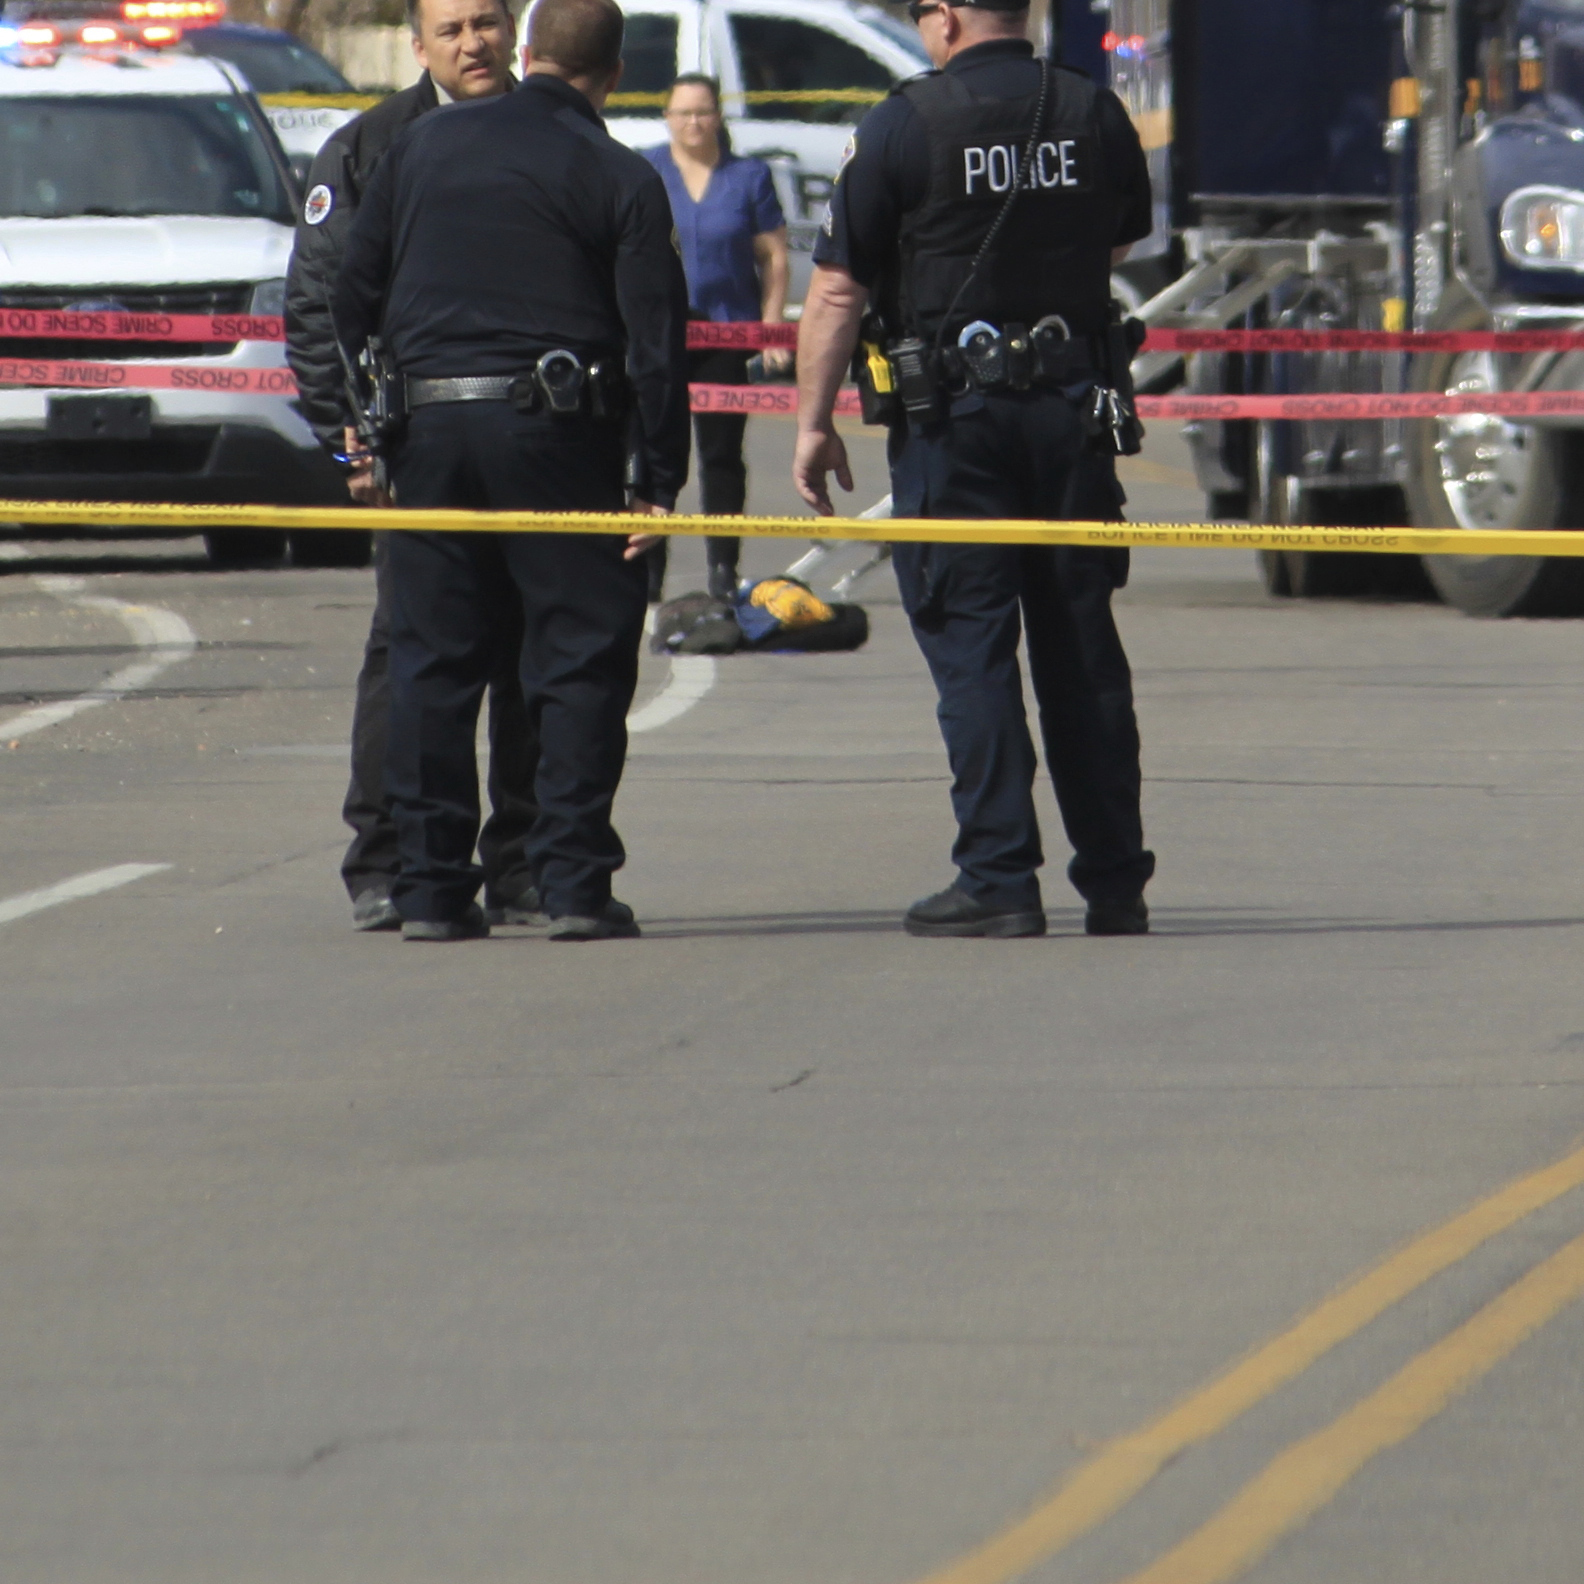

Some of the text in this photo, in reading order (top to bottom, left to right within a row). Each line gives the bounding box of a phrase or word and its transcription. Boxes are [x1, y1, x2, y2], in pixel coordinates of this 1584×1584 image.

[964, 140, 1079, 195] POLICE
[8, 311, 37, 332] DO
[43, 314, 106, 335] SCENE
[113, 316, 173, 337] CRIME
[211, 318, 280, 340] CROSS
[56, 363, 125, 385] CRIME
[171, 367, 248, 389] CROSS
[691, 389, 790, 409] SCENE D
